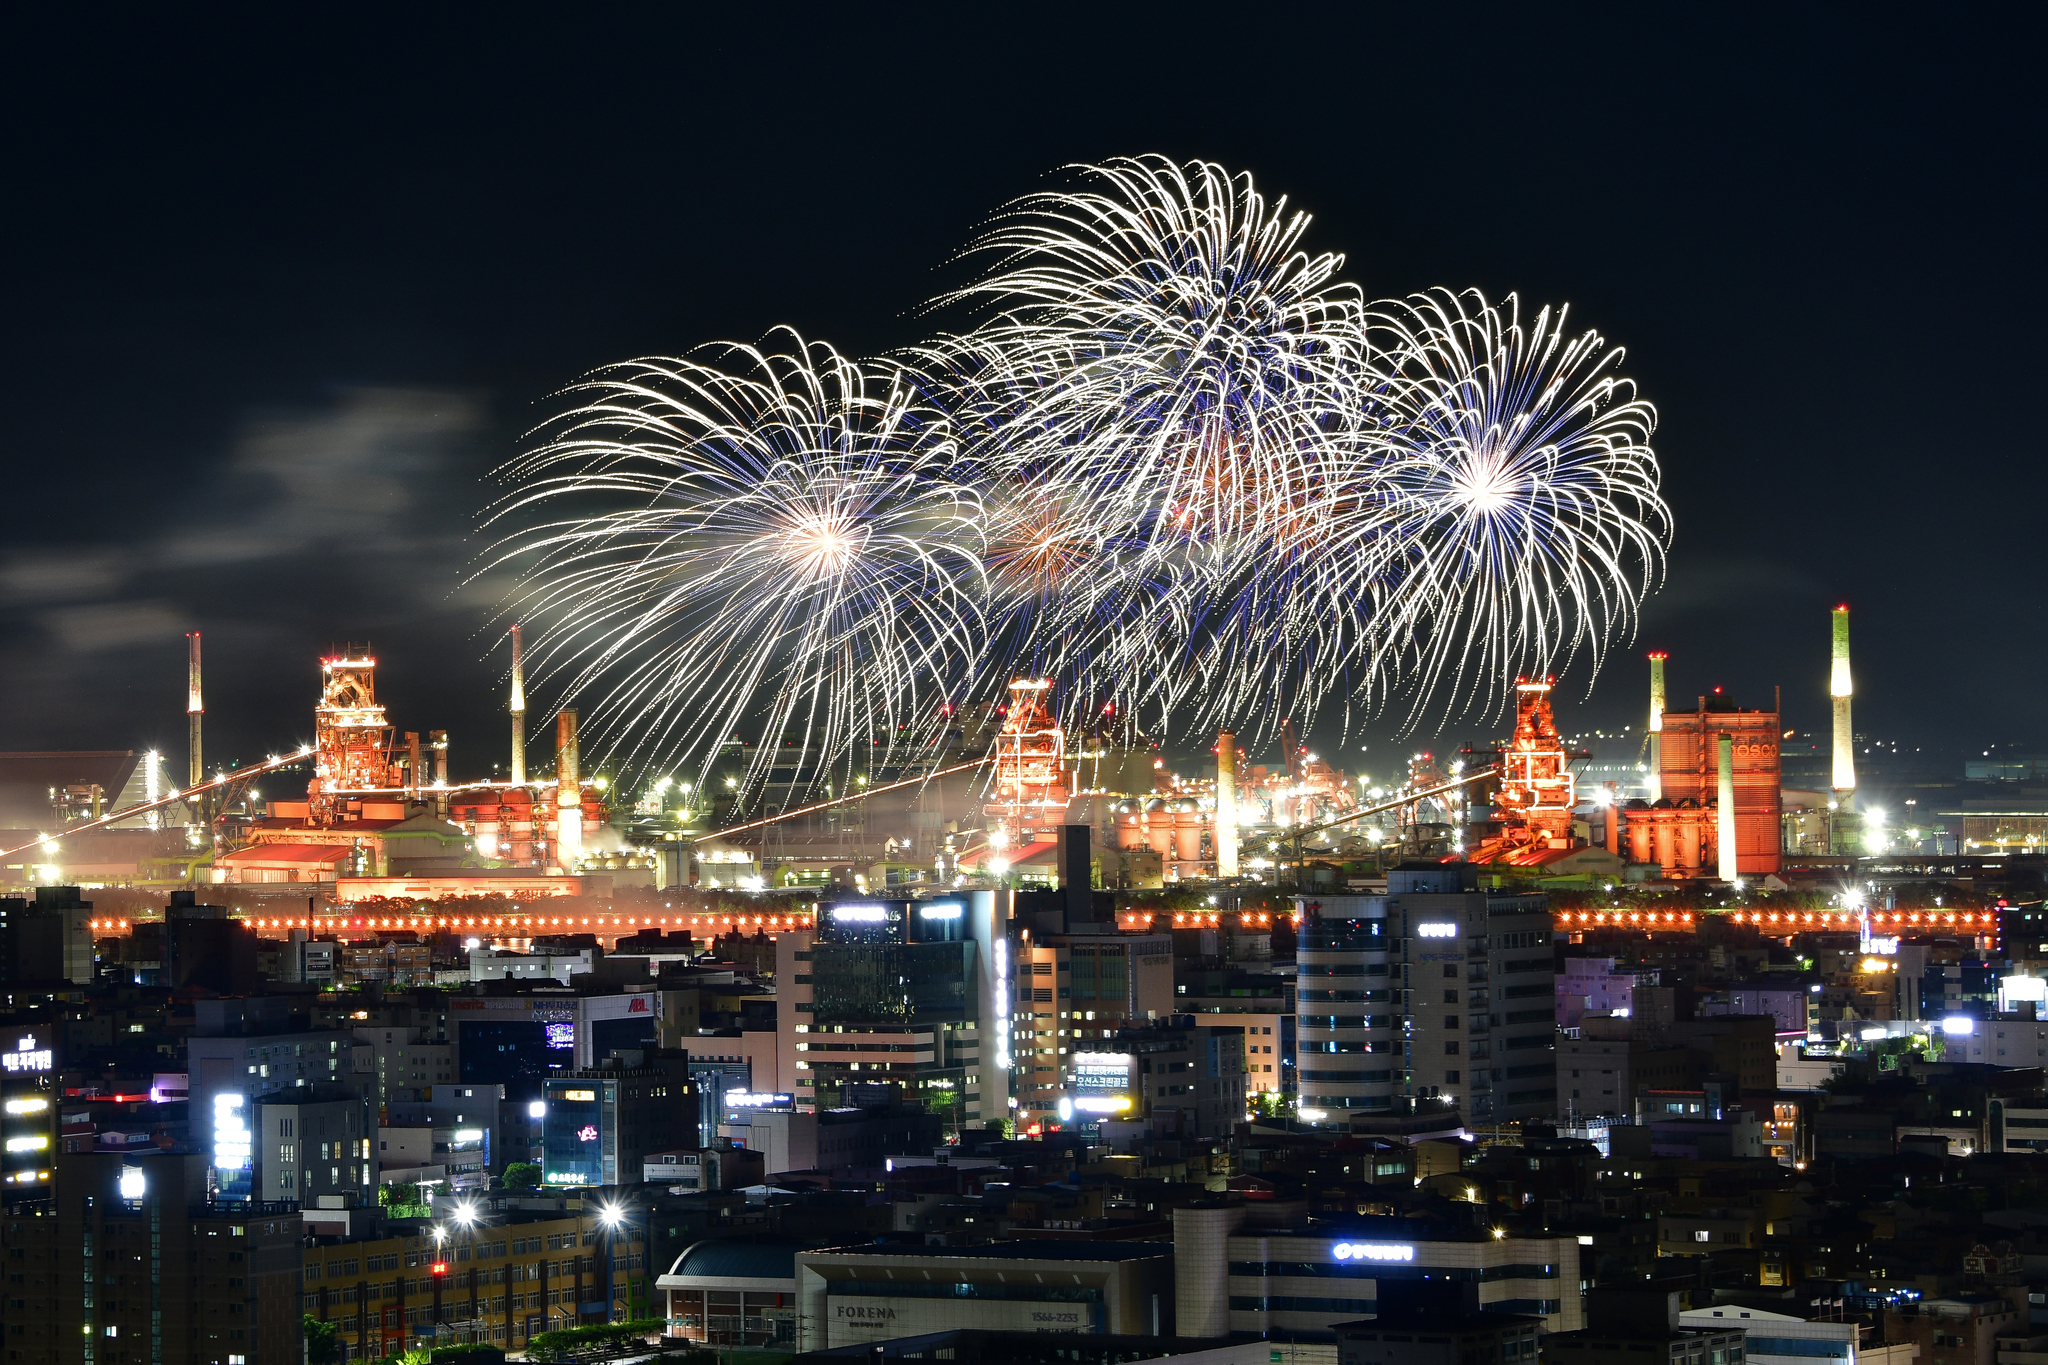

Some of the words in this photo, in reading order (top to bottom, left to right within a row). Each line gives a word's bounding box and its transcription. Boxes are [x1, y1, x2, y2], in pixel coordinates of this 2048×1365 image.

[452, 999, 484, 1009] meritz
[629, 998, 650, 1013] ABL
[837, 1306, 896, 1319] FORENA
[1032, 1312, 1078, 1322] 1566-2233
